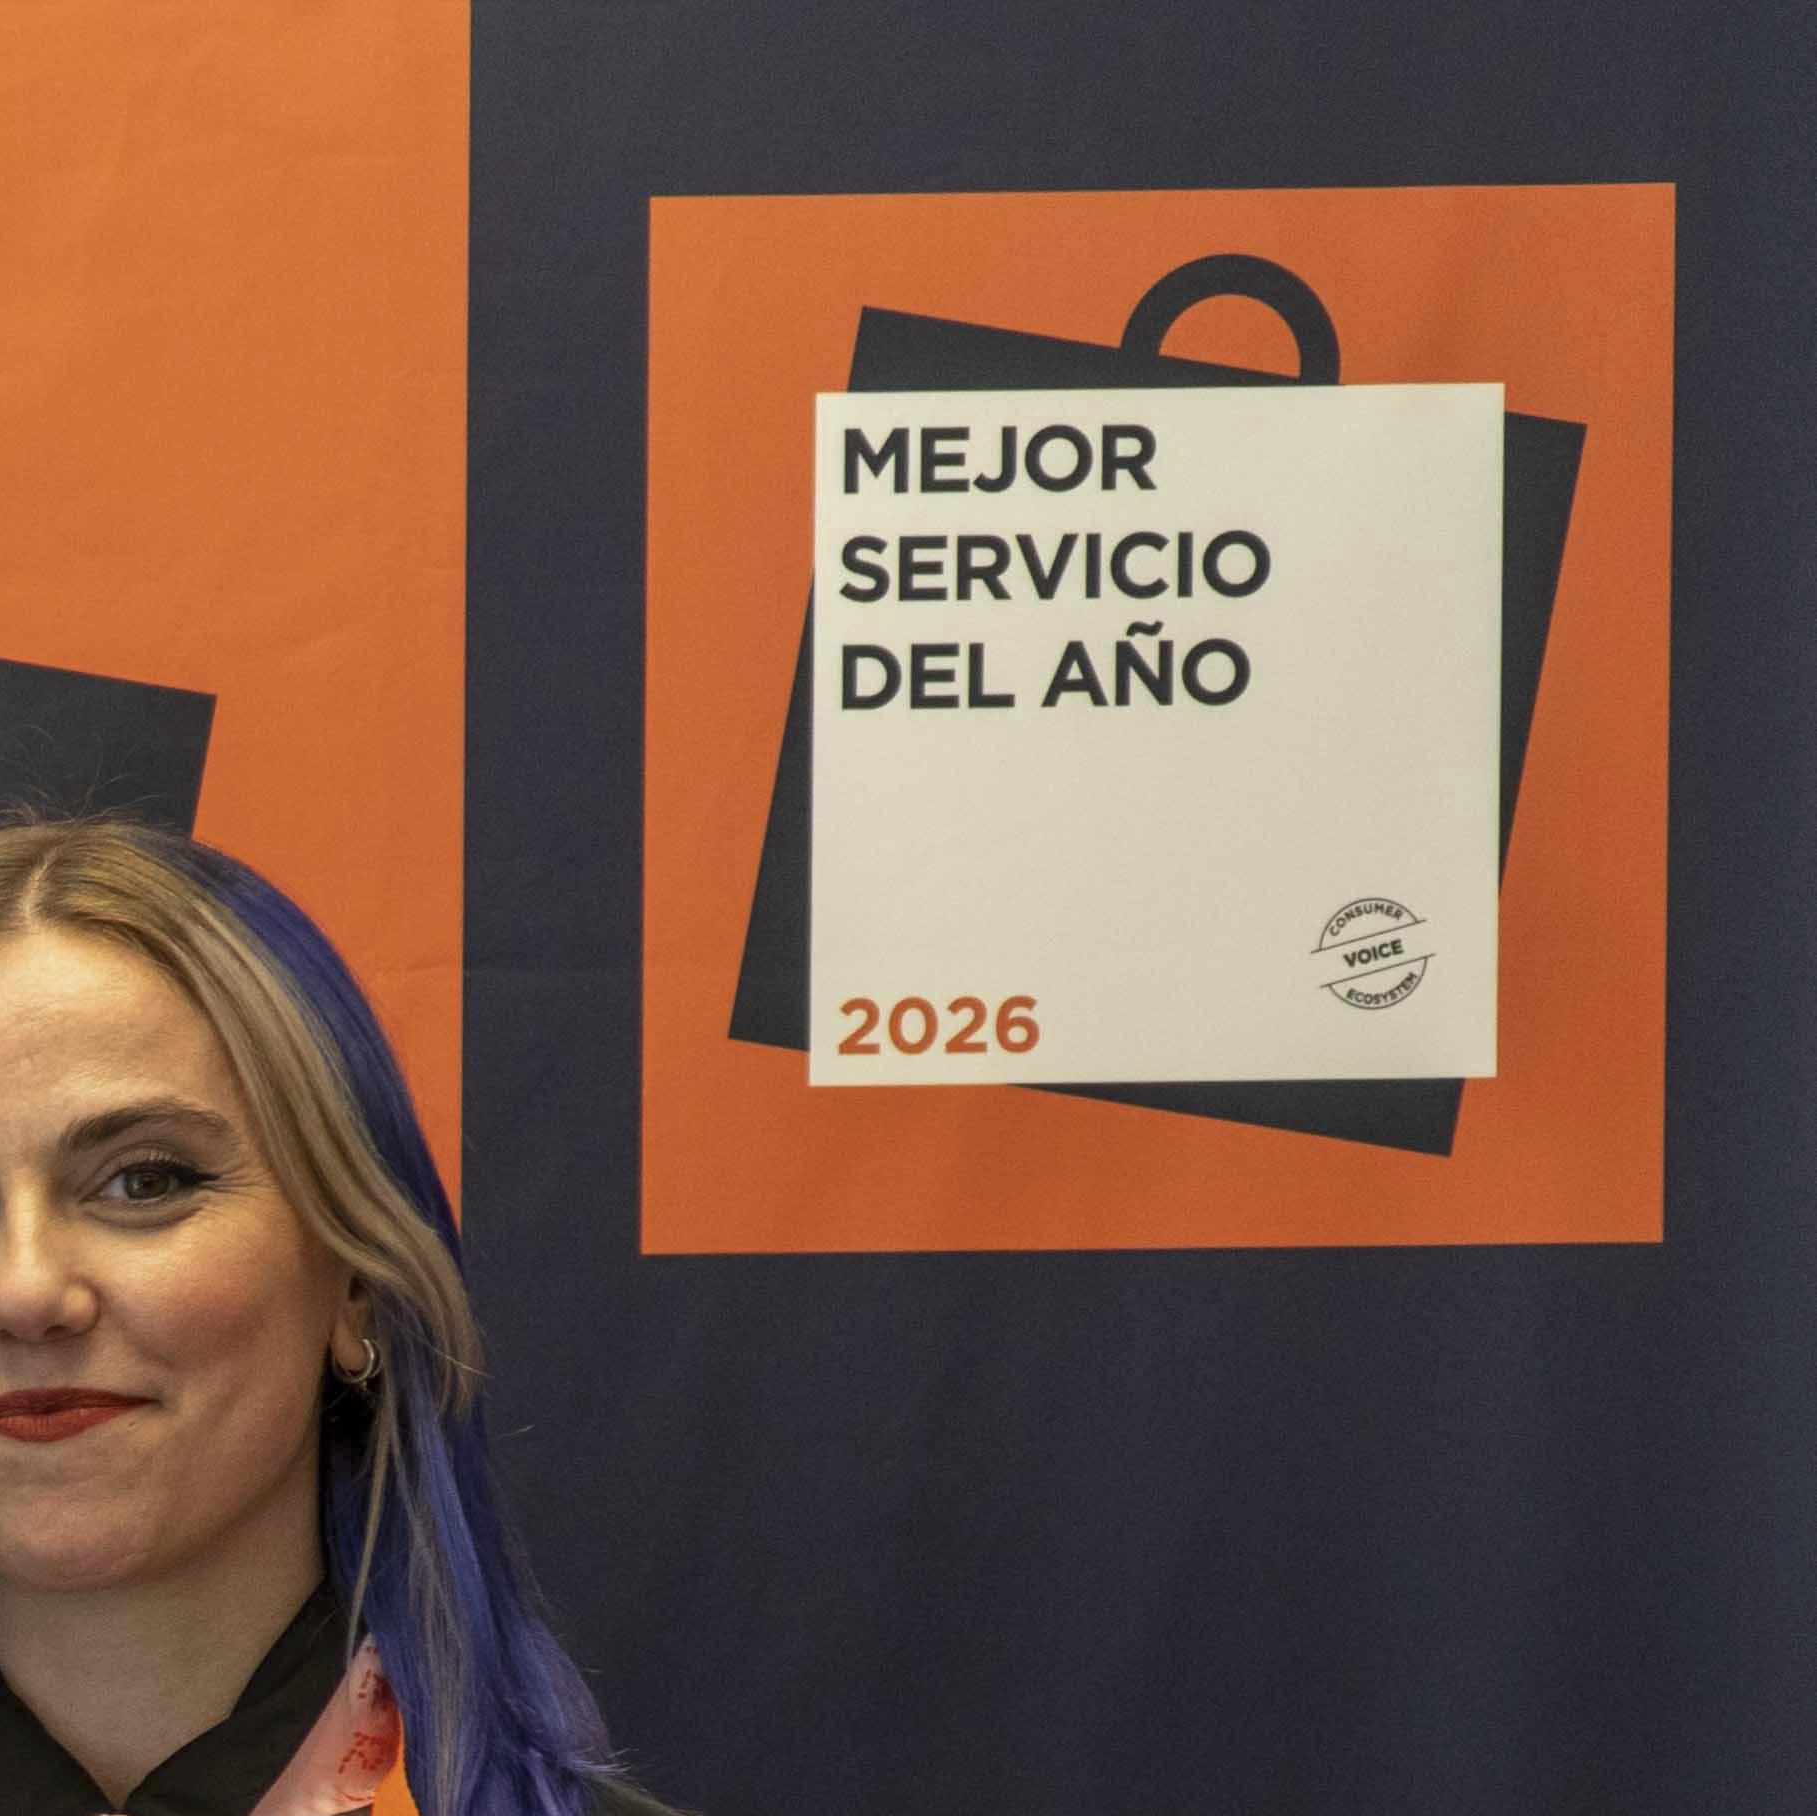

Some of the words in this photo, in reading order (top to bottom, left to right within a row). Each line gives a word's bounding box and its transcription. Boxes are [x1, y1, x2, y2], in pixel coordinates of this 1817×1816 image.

[844, 425, 1156, 494] MEJOR
[840, 530, 1270, 602] SERVICIO
[842, 643, 1015, 710] DEL
[1042, 621, 1250, 707] AÑO
[1329, 903, 1404, 936] CONSUMER
[1343, 939, 1404, 968] VOICE
[1346, 971, 1418, 1005] ECOSYSTEM
[838, 996, 1039, 1055] 2026
